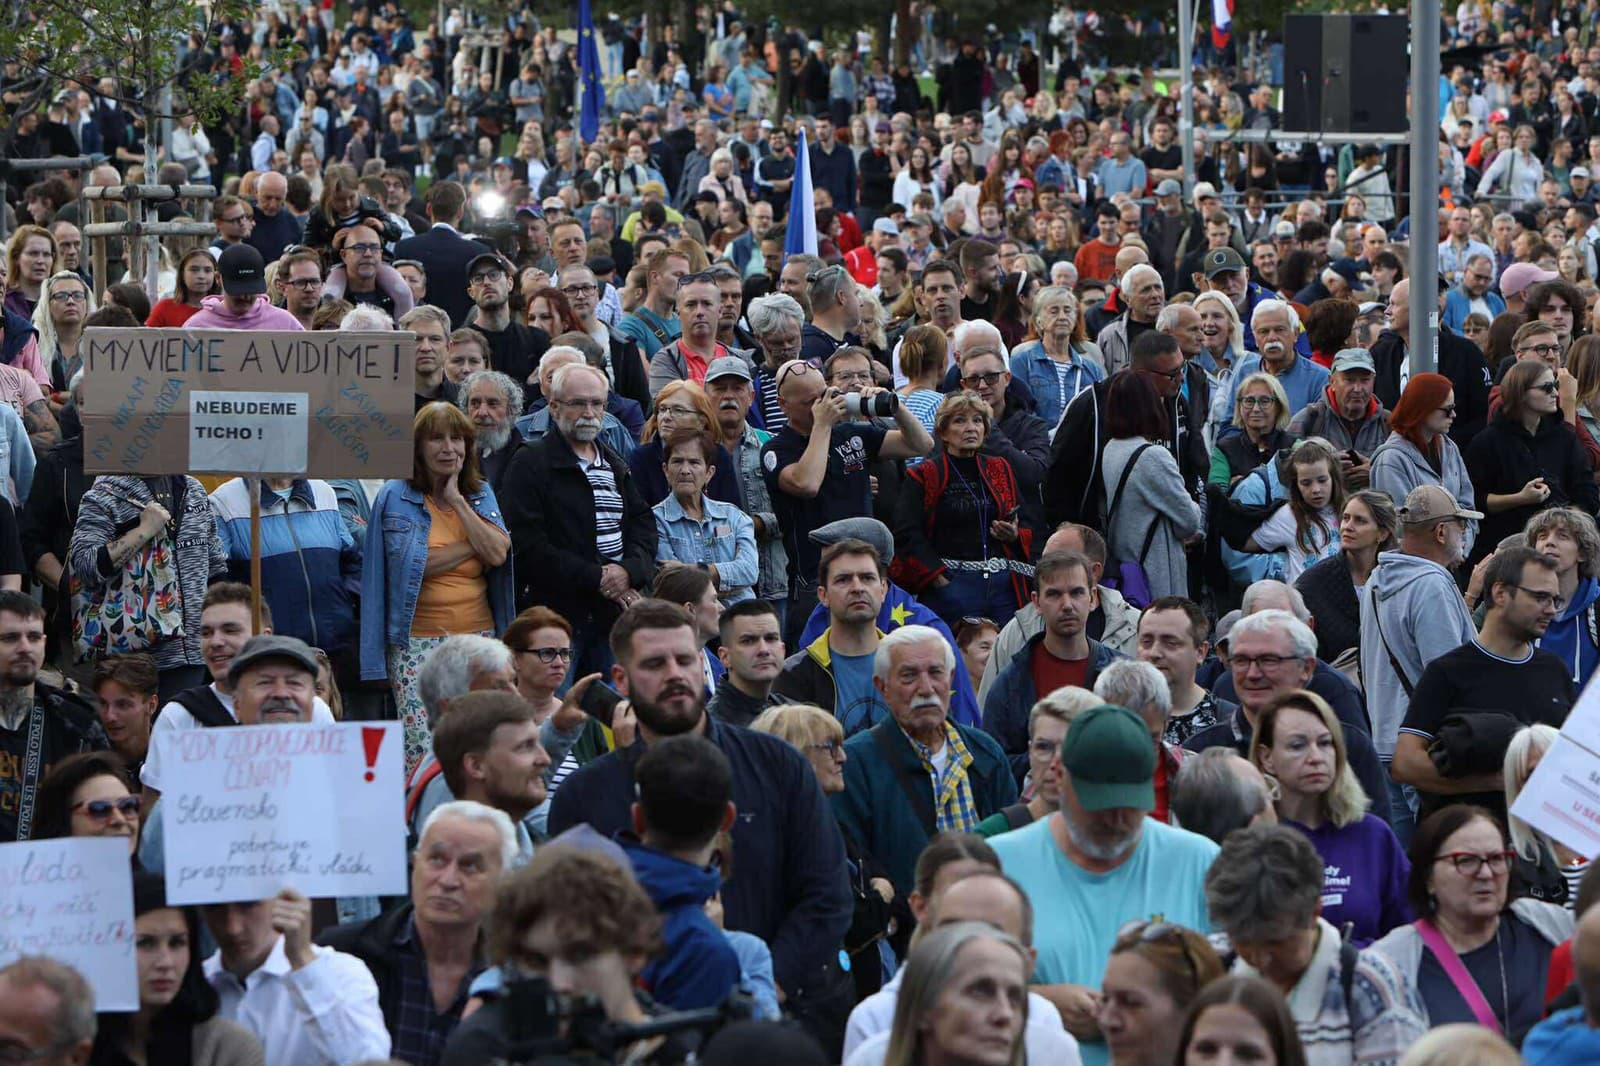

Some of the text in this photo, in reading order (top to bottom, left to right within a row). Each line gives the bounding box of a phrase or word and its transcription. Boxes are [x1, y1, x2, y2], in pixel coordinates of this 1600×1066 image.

[89, 337, 401, 381] MY VIEME A VIDÍME !
[195, 400, 297, 416] NEBUDEME
[194, 426, 263, 441] TICHO !
[30, 724, 41, 749] POLO
[176, 791, 280, 826] Slovensko
